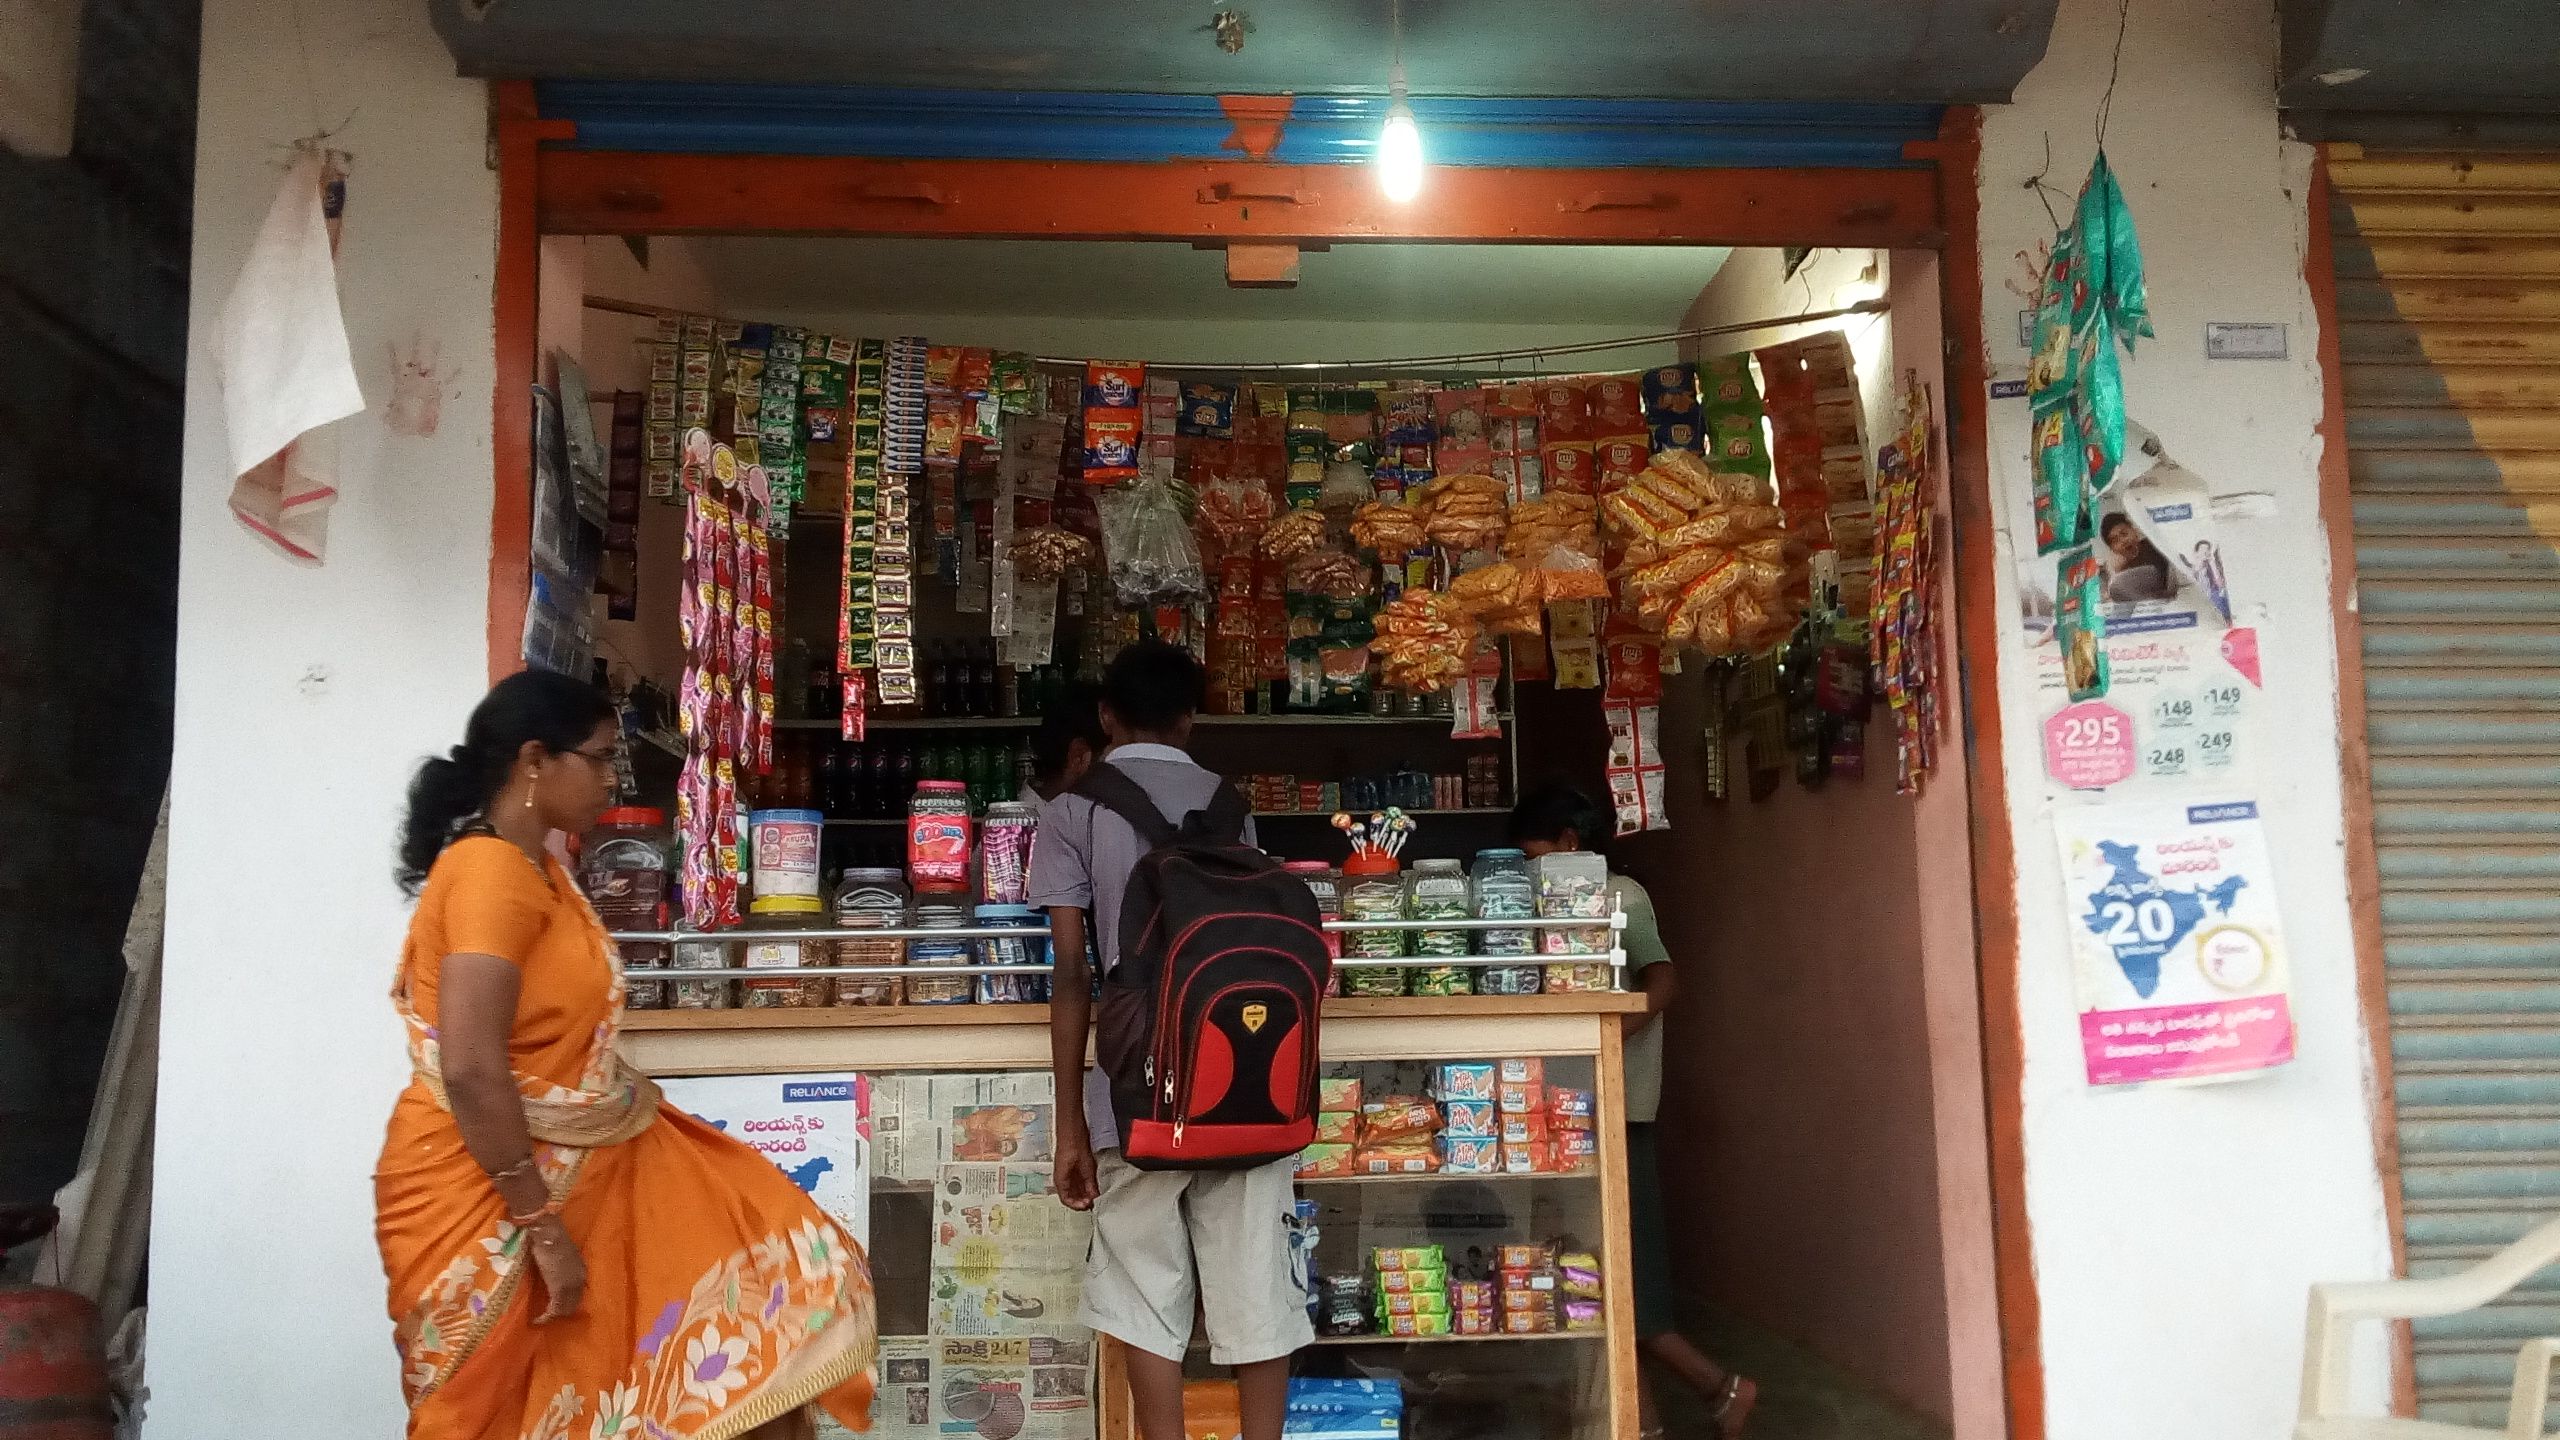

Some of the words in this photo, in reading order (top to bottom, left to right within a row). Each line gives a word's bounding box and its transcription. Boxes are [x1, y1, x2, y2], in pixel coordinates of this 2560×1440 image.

[1105, 380, 1125, 391] Surf
[1995, 384, 2025, 394] RELIA
[1103, 441, 1123, 453] Surf
[2101, 898, 2176, 946] 20
[788, 1086, 848, 1098] RELIANCE
